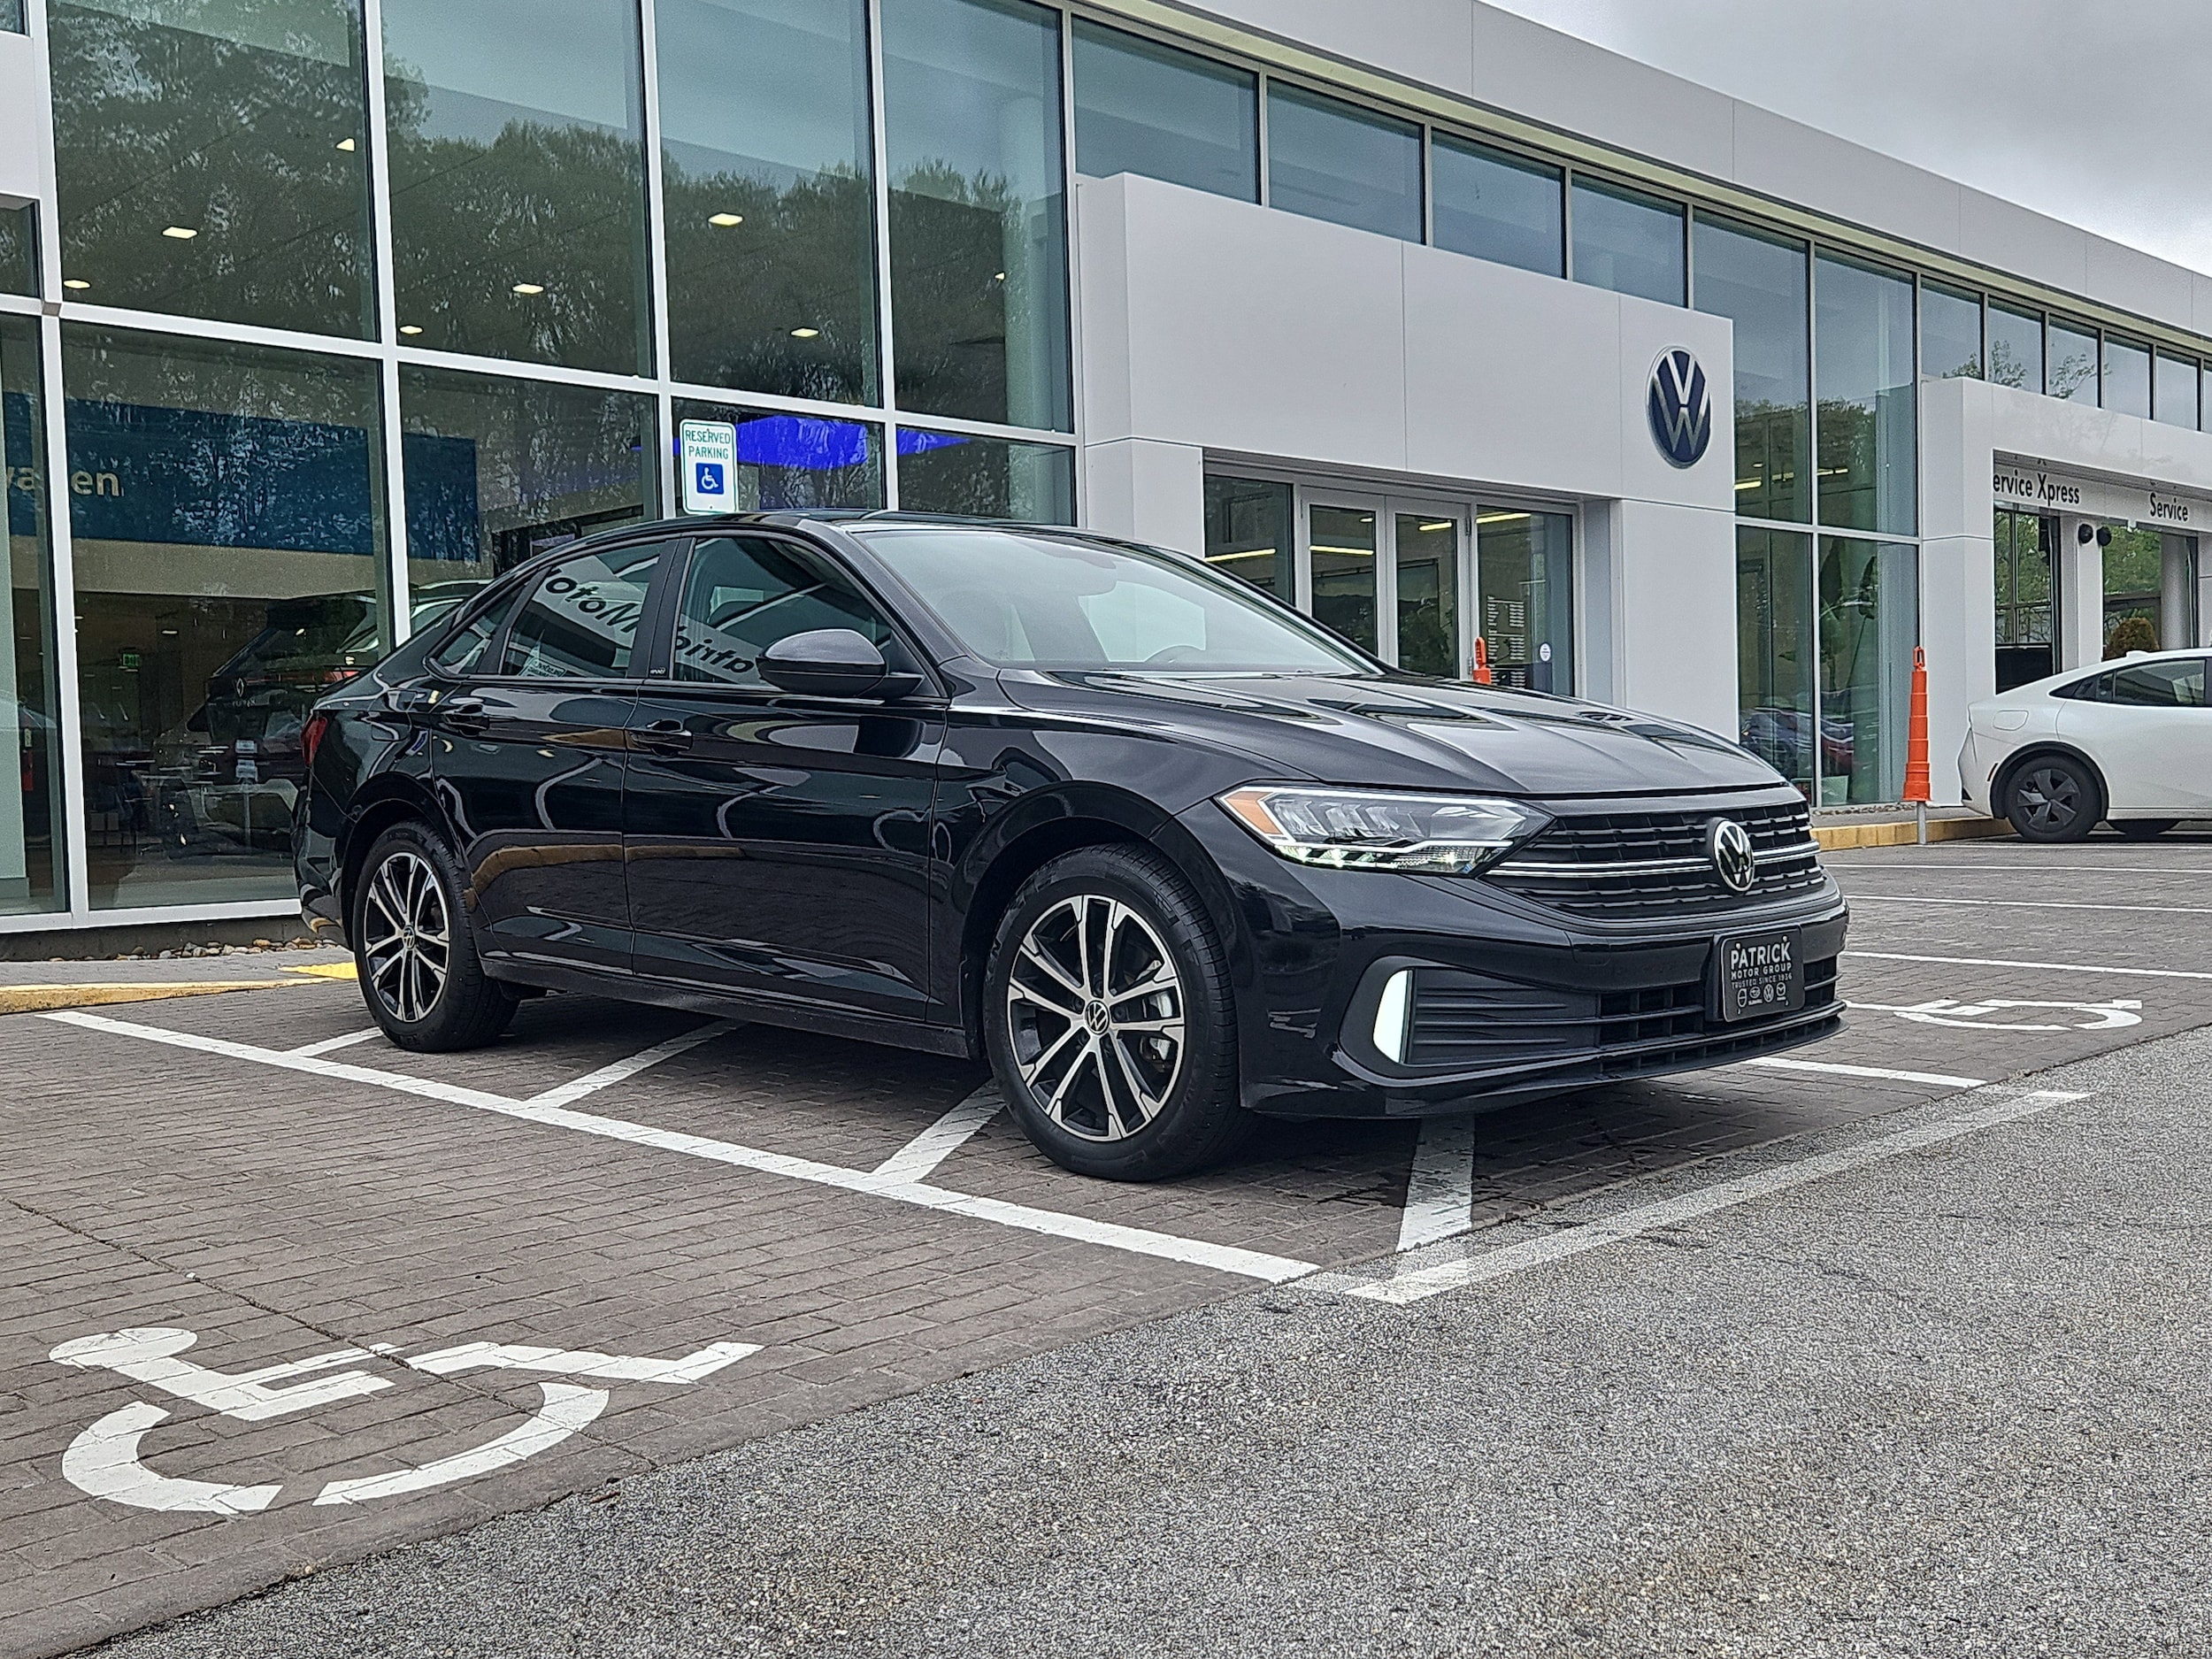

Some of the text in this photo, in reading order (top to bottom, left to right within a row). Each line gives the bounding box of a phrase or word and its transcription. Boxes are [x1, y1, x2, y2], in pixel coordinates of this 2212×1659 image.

[685, 429, 731, 444] RESERVED
[688, 445, 729, 459] PARKING
[1993, 469, 2080, 506] ervice Xpress
[2149, 492, 2189, 522] Service
[1731, 941, 1792, 971] PATRICK
[1731, 962, 1792, 980] MOTOR GROUP
[1759, 974, 1777, 985] SINCE
